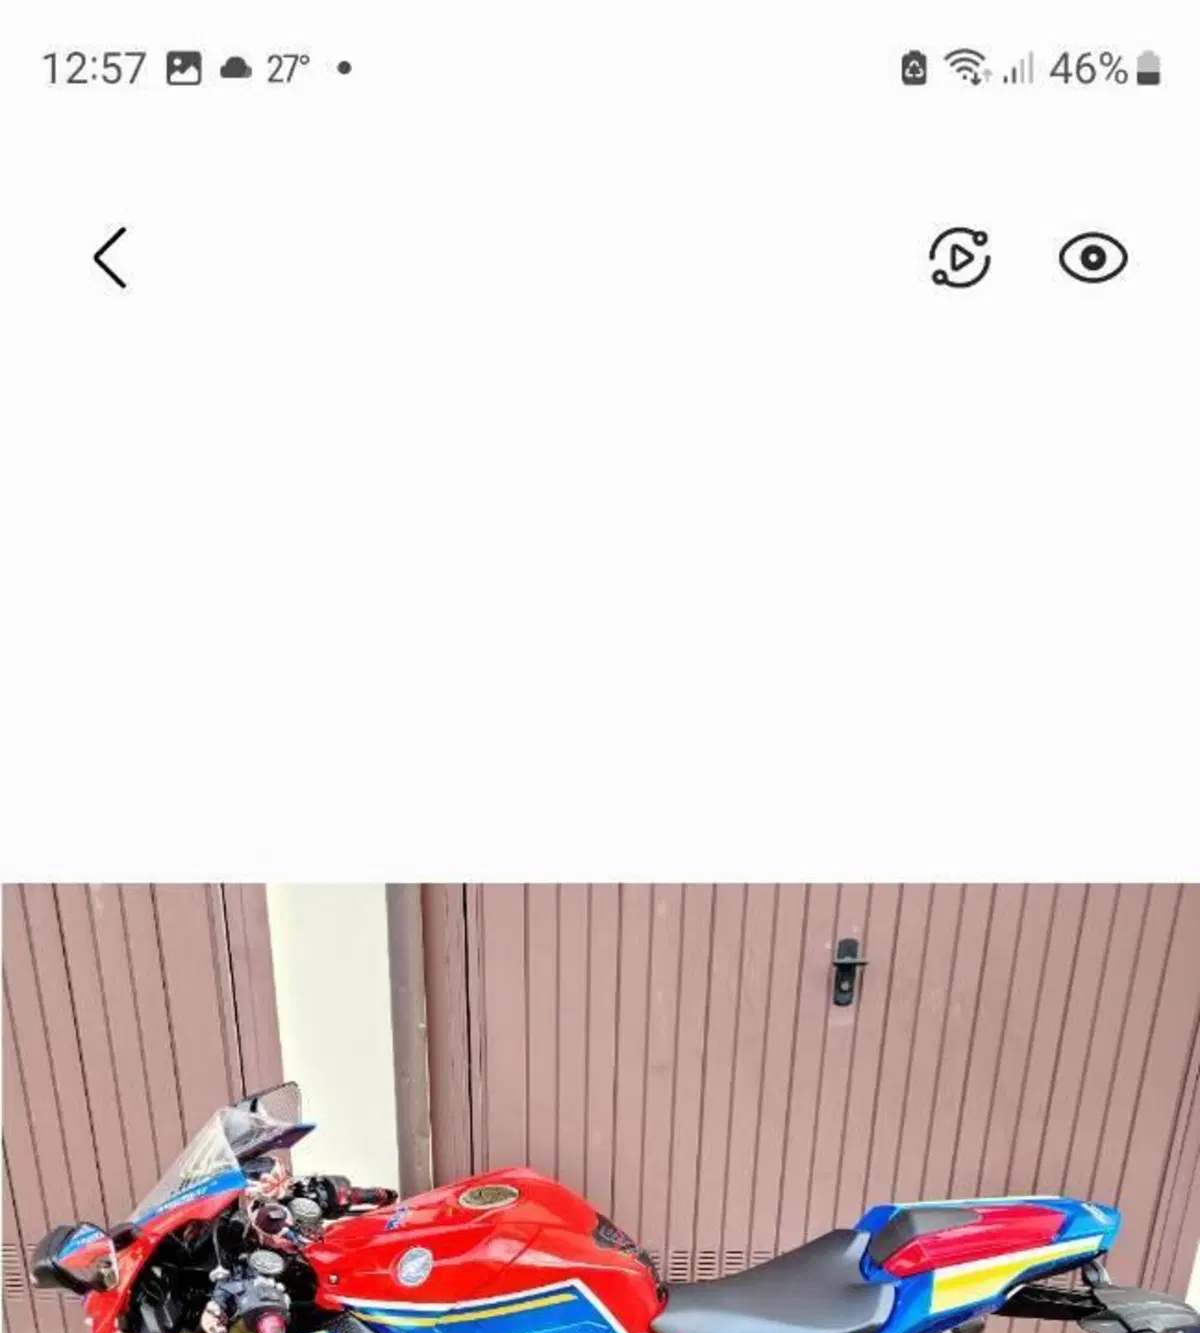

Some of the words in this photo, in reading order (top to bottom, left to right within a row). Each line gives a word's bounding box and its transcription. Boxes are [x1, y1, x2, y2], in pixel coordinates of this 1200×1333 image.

[42, 51, 147, 85] 12:57
[267, 54, 310, 83] 27°
[1049, 51, 1129, 85] 46%
